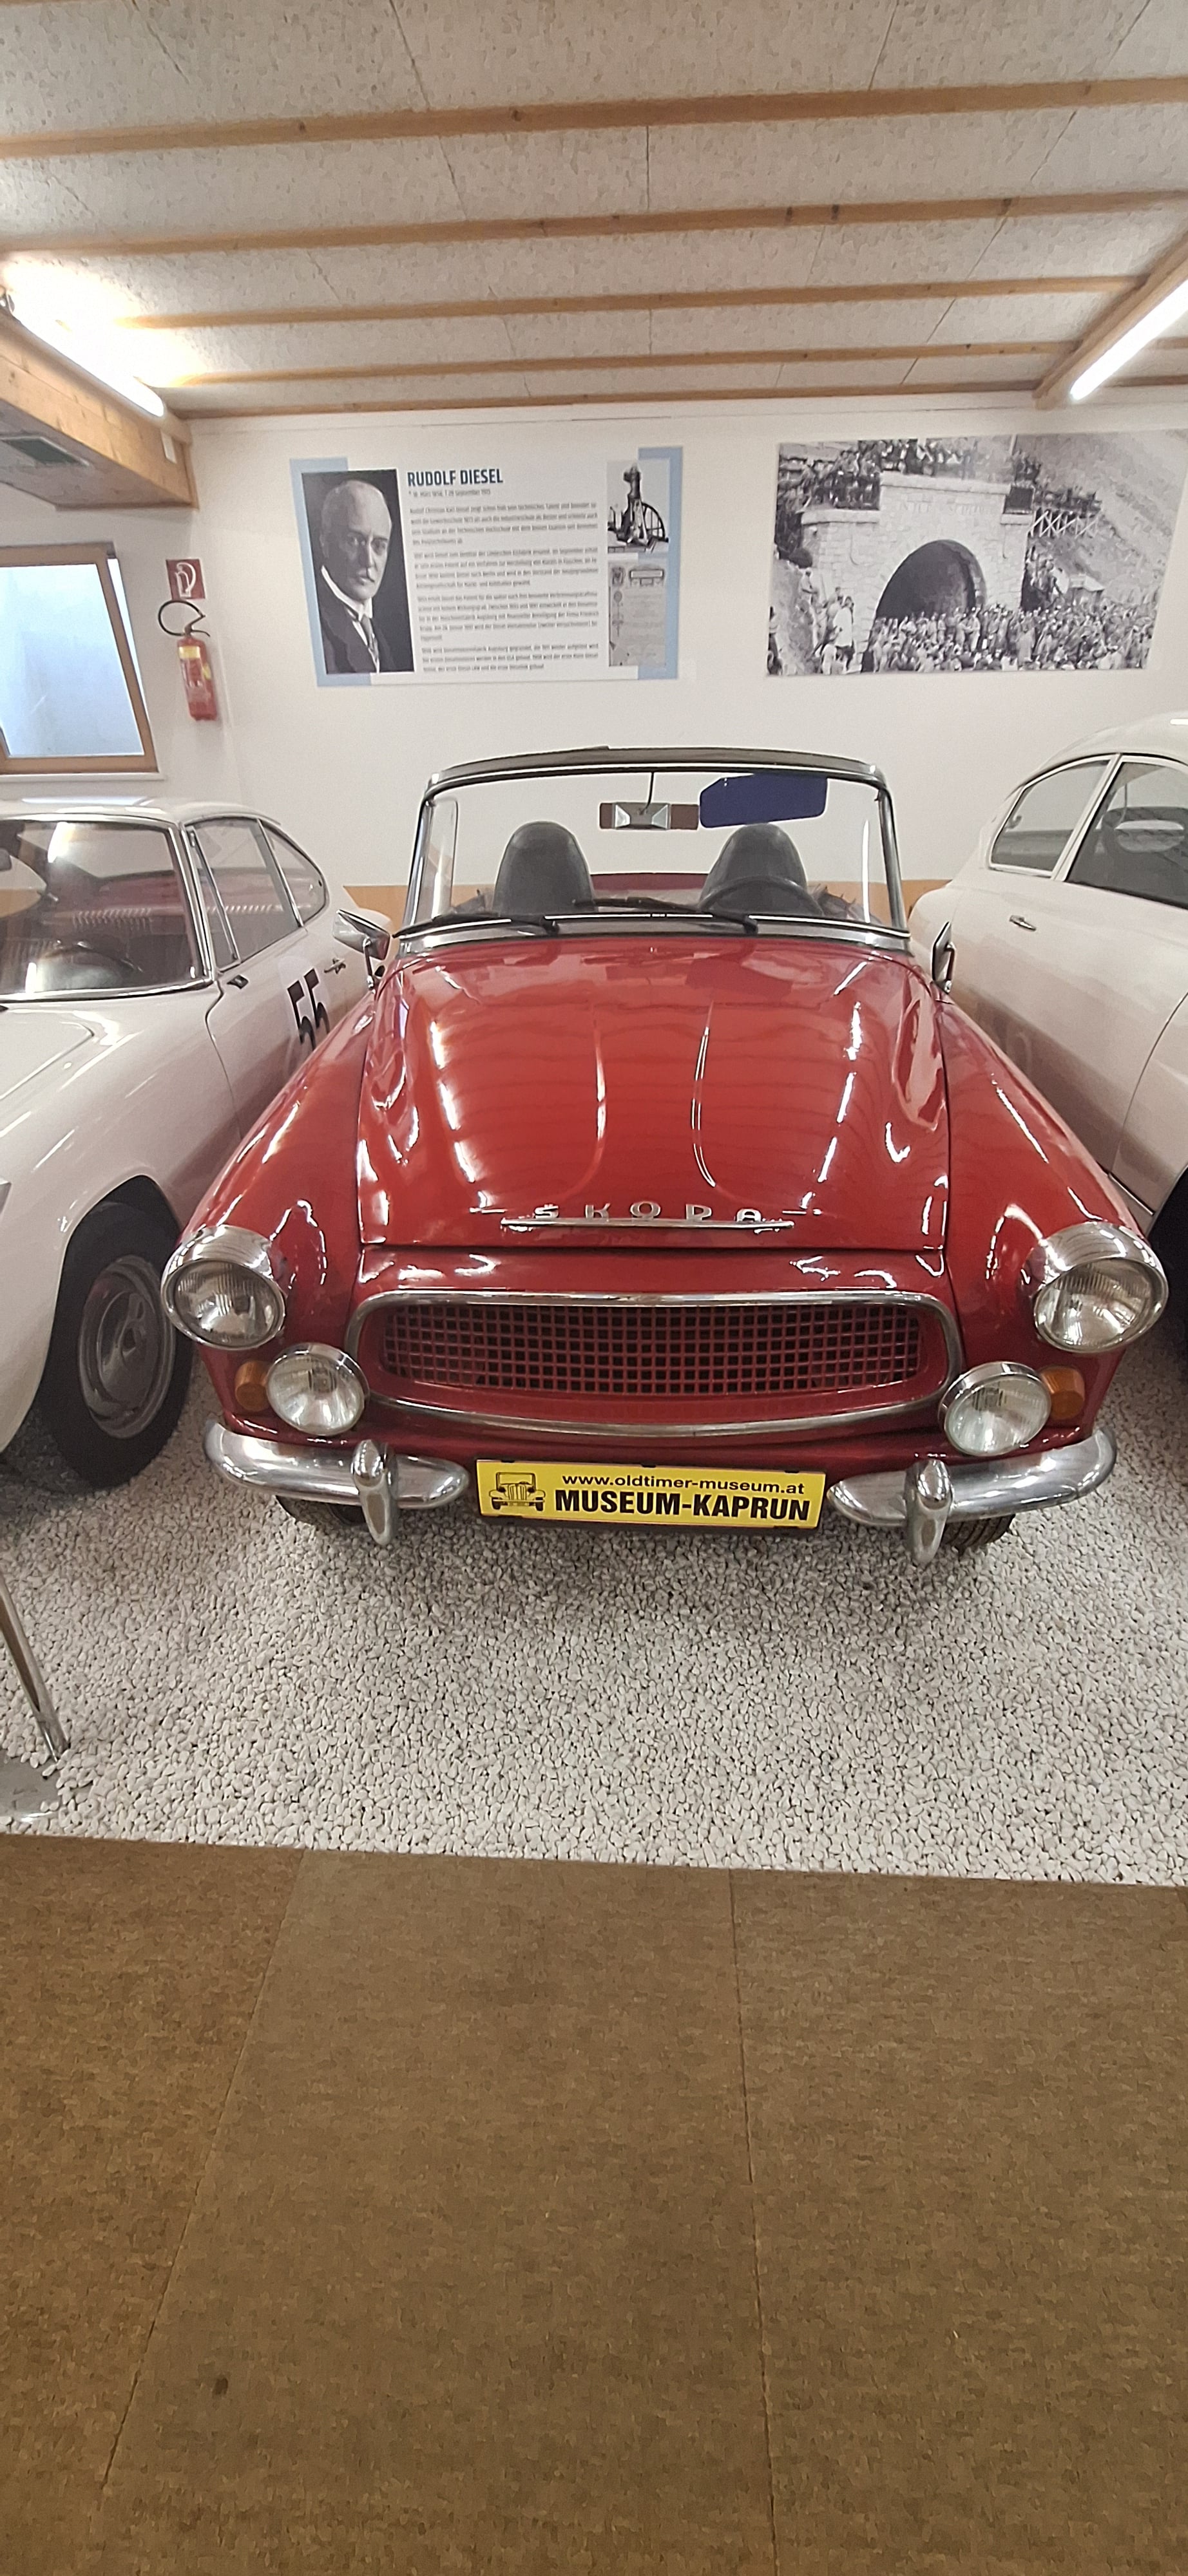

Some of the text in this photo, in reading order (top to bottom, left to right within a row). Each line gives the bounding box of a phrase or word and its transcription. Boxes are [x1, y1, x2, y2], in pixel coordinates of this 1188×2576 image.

[407, 468, 503, 487] RUDOLF DIESEL
[287, 968, 330, 1051] 55
[562, 1474, 805, 1494] www.oldtimer-museum.at
[555, 1489, 810, 1521] MUSEUM-KAPRUN
